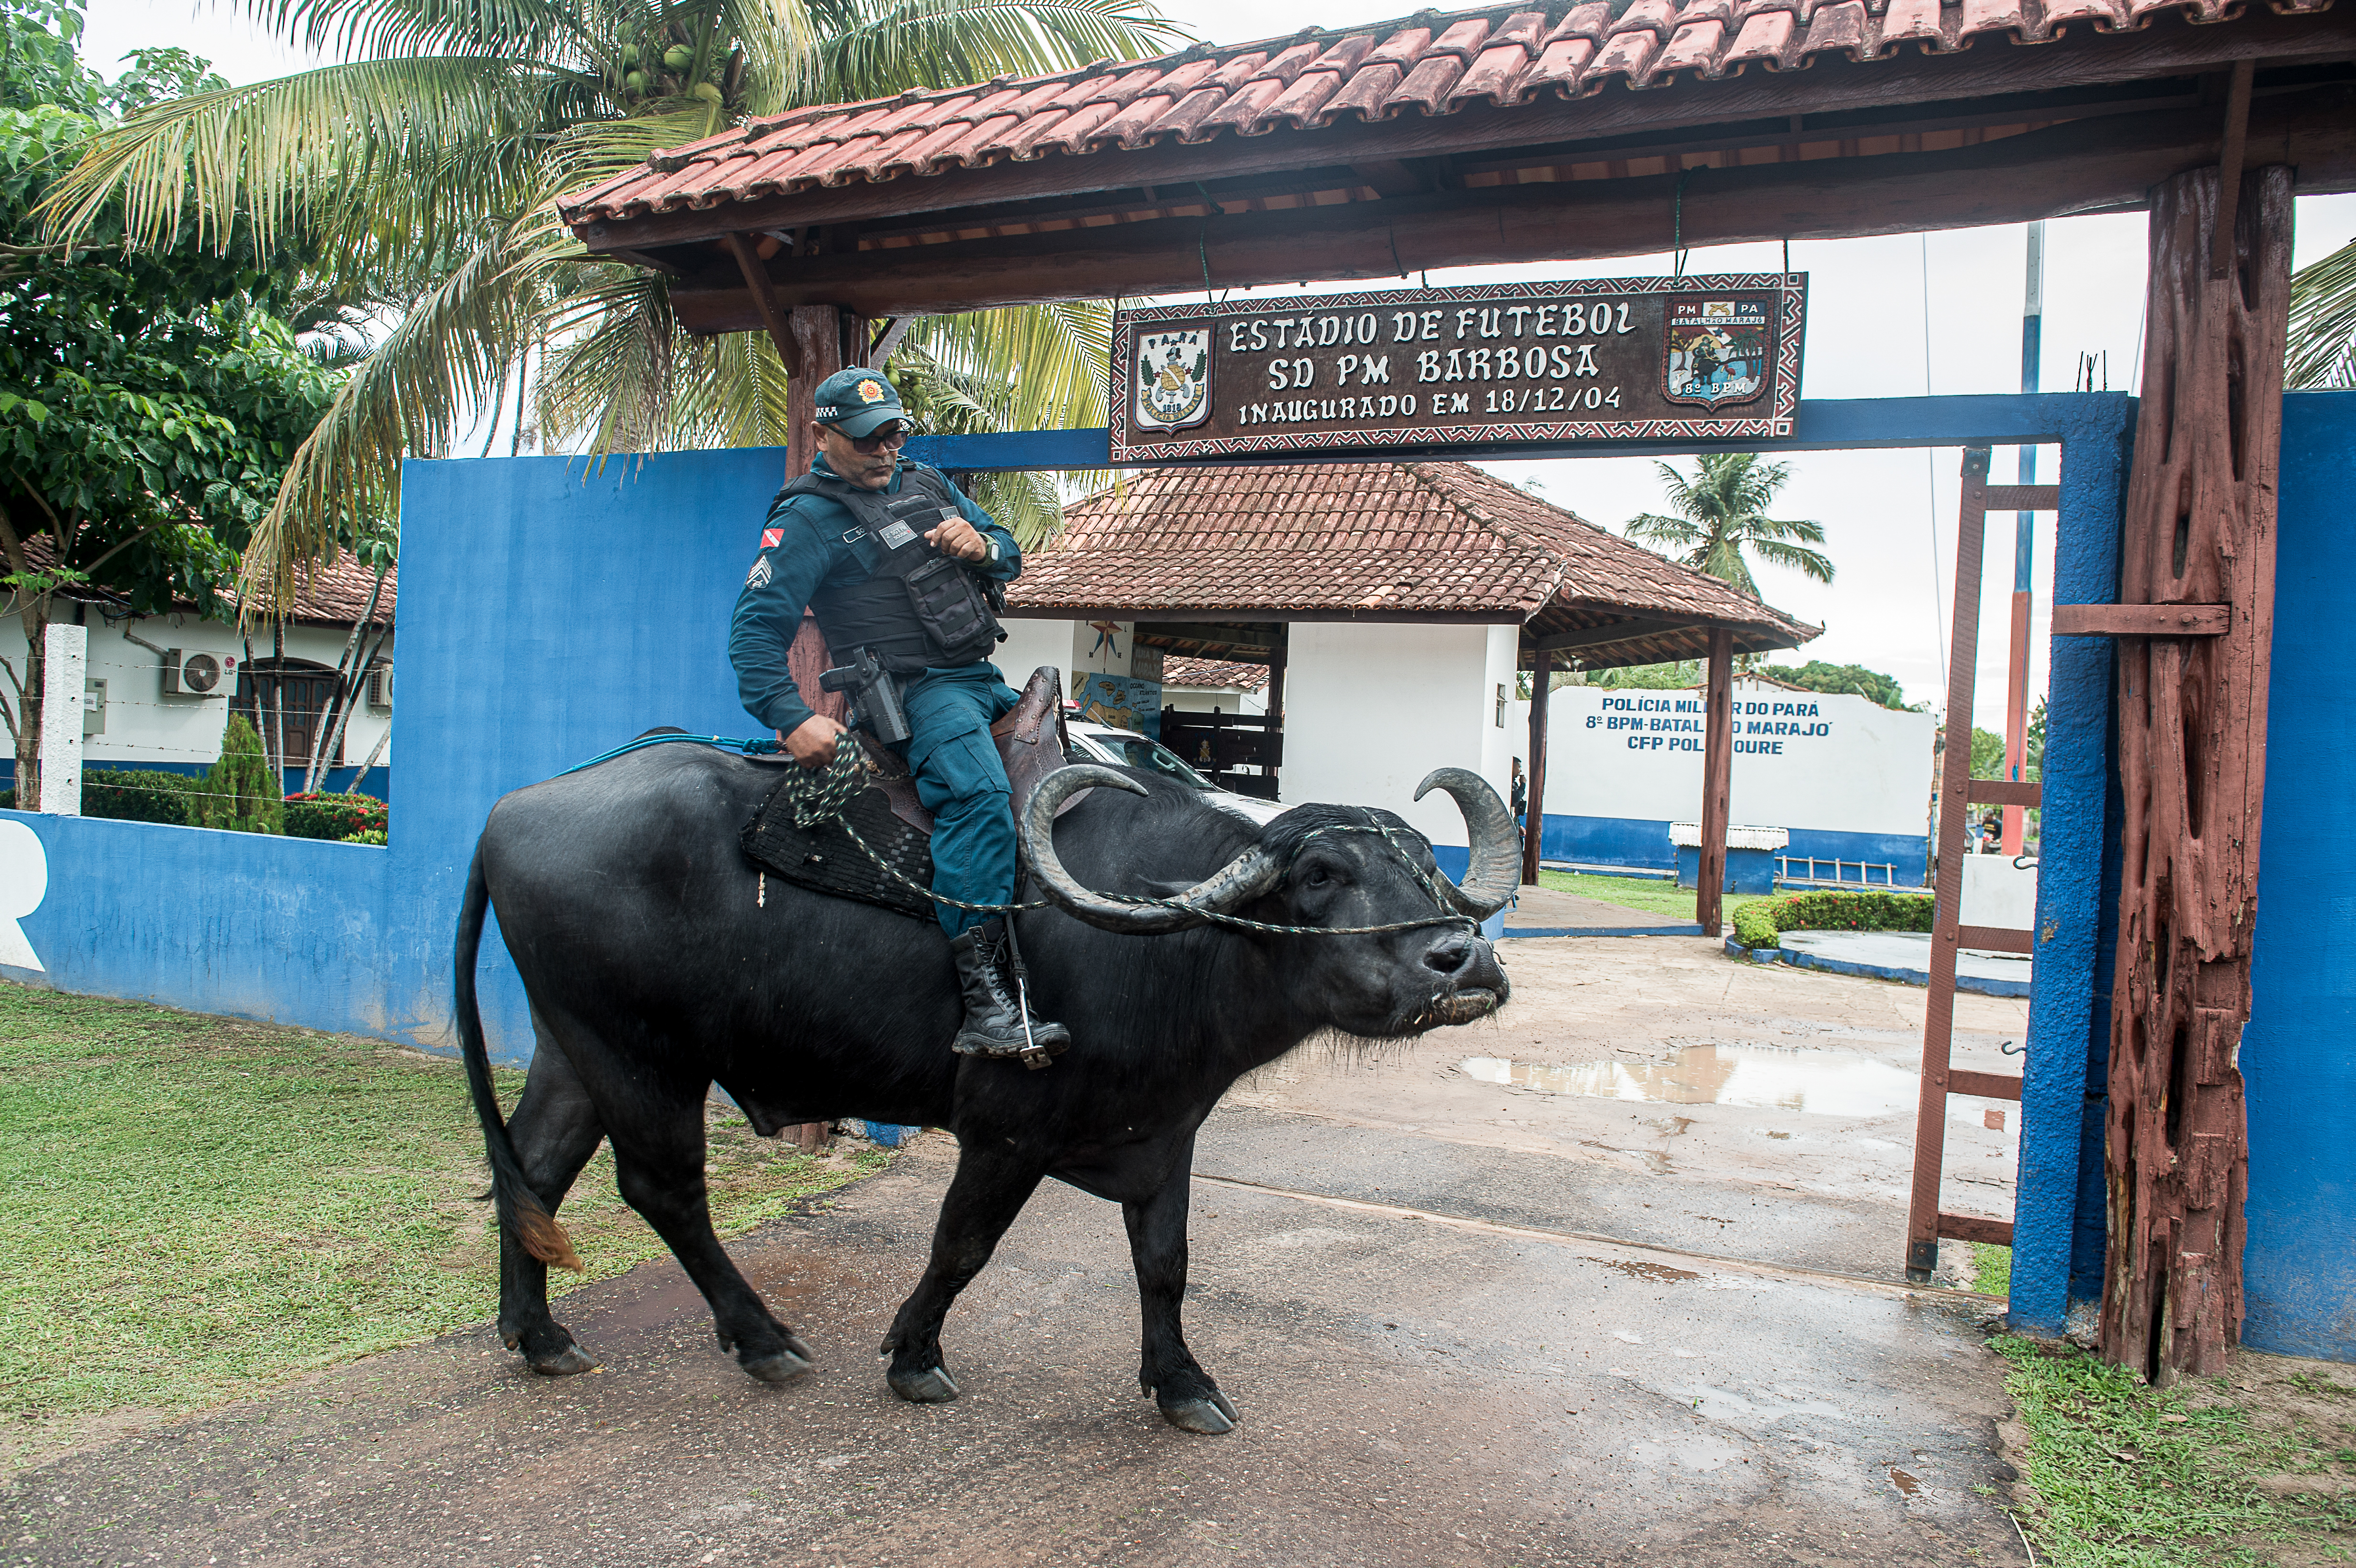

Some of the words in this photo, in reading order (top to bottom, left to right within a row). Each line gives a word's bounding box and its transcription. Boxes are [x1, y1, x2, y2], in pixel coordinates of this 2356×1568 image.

[1678, 305, 1696, 315] PM
[1741, 304, 1758, 314] PA
[1230, 310, 1377, 352] ESTÁDIO
[1392, 310, 1443, 342] DE
[1456, 302, 1636, 339] FUTEBOL
[1148, 330, 1200, 349] PARÁ
[1268, 357, 1314, 390] SD
[1336, 354, 1390, 386] PM
[1416, 344, 1599, 382] BARBOSA
[1711, 382, 1746, 394] BPM
[1162, 403, 1182, 413] 1818
[1239, 394, 1416, 425] INAUGURADO
[1432, 392, 1470, 414] EM
[1485, 386, 1621, 413] 18/12/04
[890, 527, 901, 536] SGT
[1602, 696, 1671, 712] POLÍCIA
[1675, 700, 1742, 714] MILIR
[1745, 702, 1768, 715] DO
[1772, 700, 1819, 717] PARÁ
[1627, 736, 1663, 750] CFP
[1669, 738, 1705, 751] POL
[1734, 740, 1783, 754] OURE
